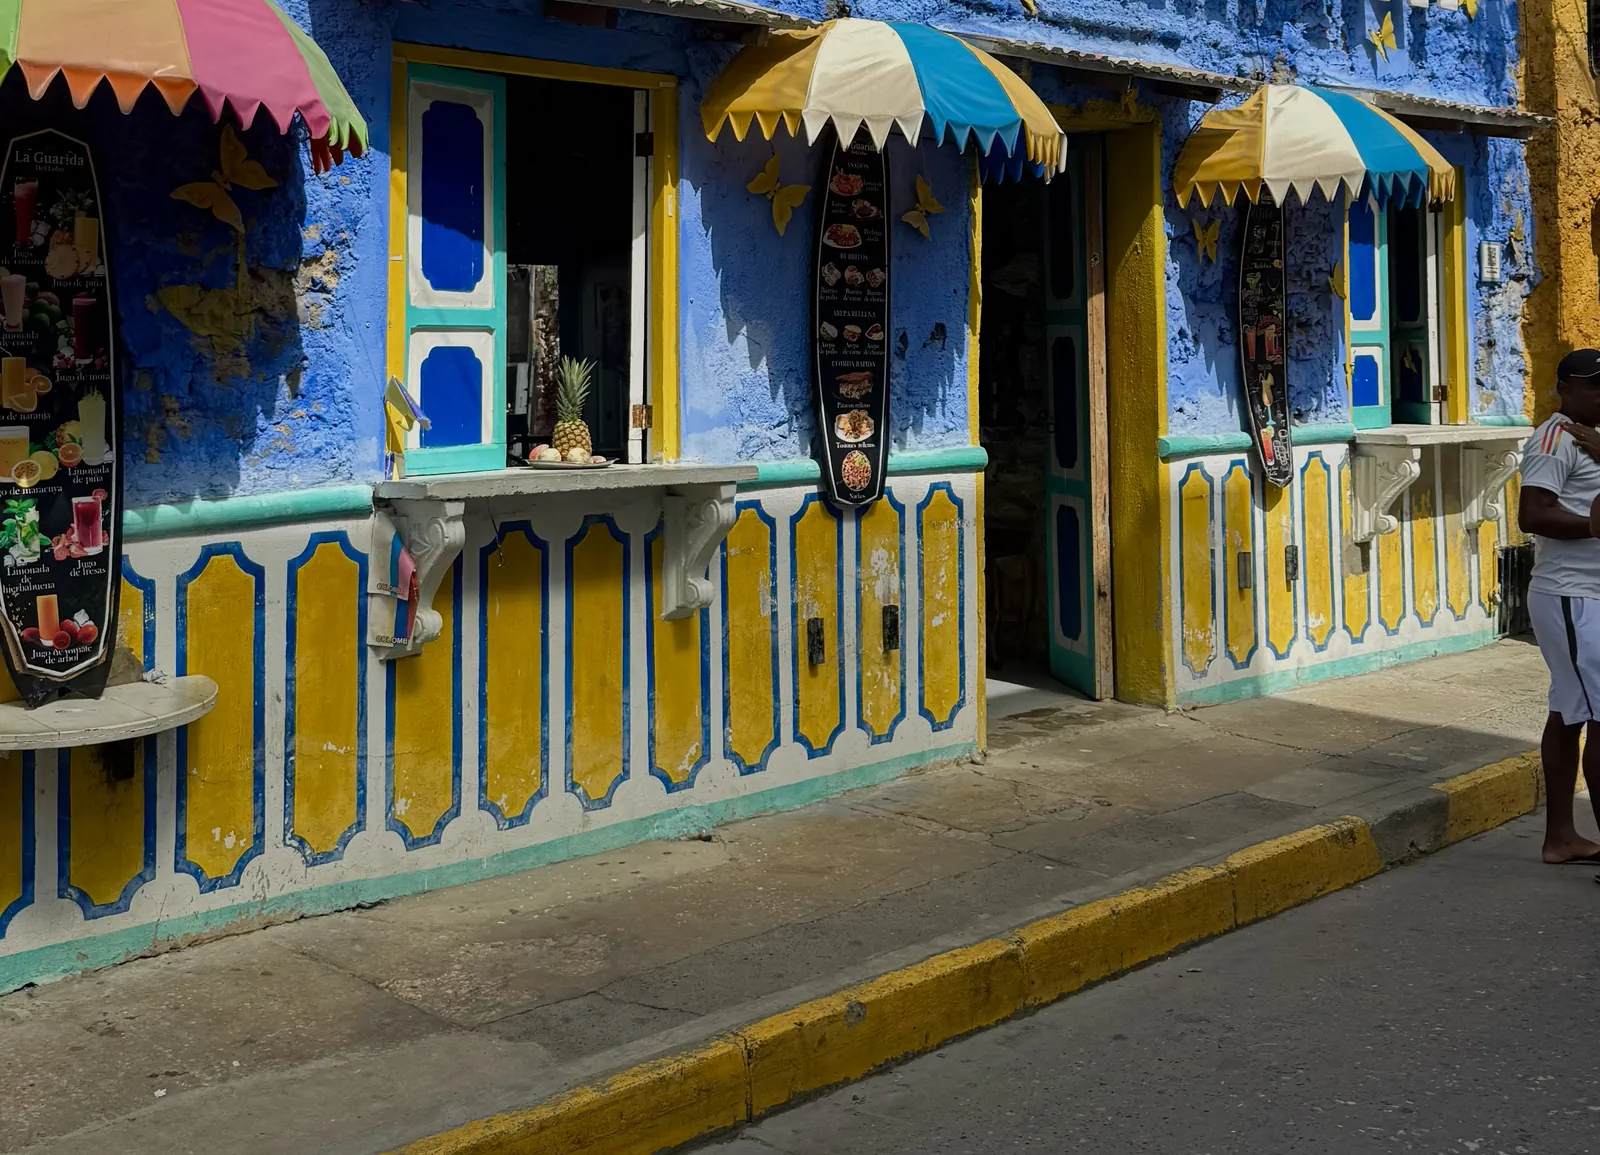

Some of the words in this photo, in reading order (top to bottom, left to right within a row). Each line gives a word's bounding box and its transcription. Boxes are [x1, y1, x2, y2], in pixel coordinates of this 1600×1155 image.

[15, 150, 30, 163] La
[52, 278, 72, 288] Jugo
[73, 278, 83, 287] de
[55, 369, 76, 383] Jugo
[77, 372, 88, 381] de
[6, 411, 18, 421] de
[68, 465, 110, 476] Limonada
[72, 476, 84, 484] de
[9, 486, 20, 495] de
[77, 559, 97, 569] Jugo
[7, 563, 50, 577] Limonada
[69, 568, 81, 577] de
[21, 575, 32, 584] de
[31, 648, 51, 660] Jugo
[45, 656, 56, 664] de
